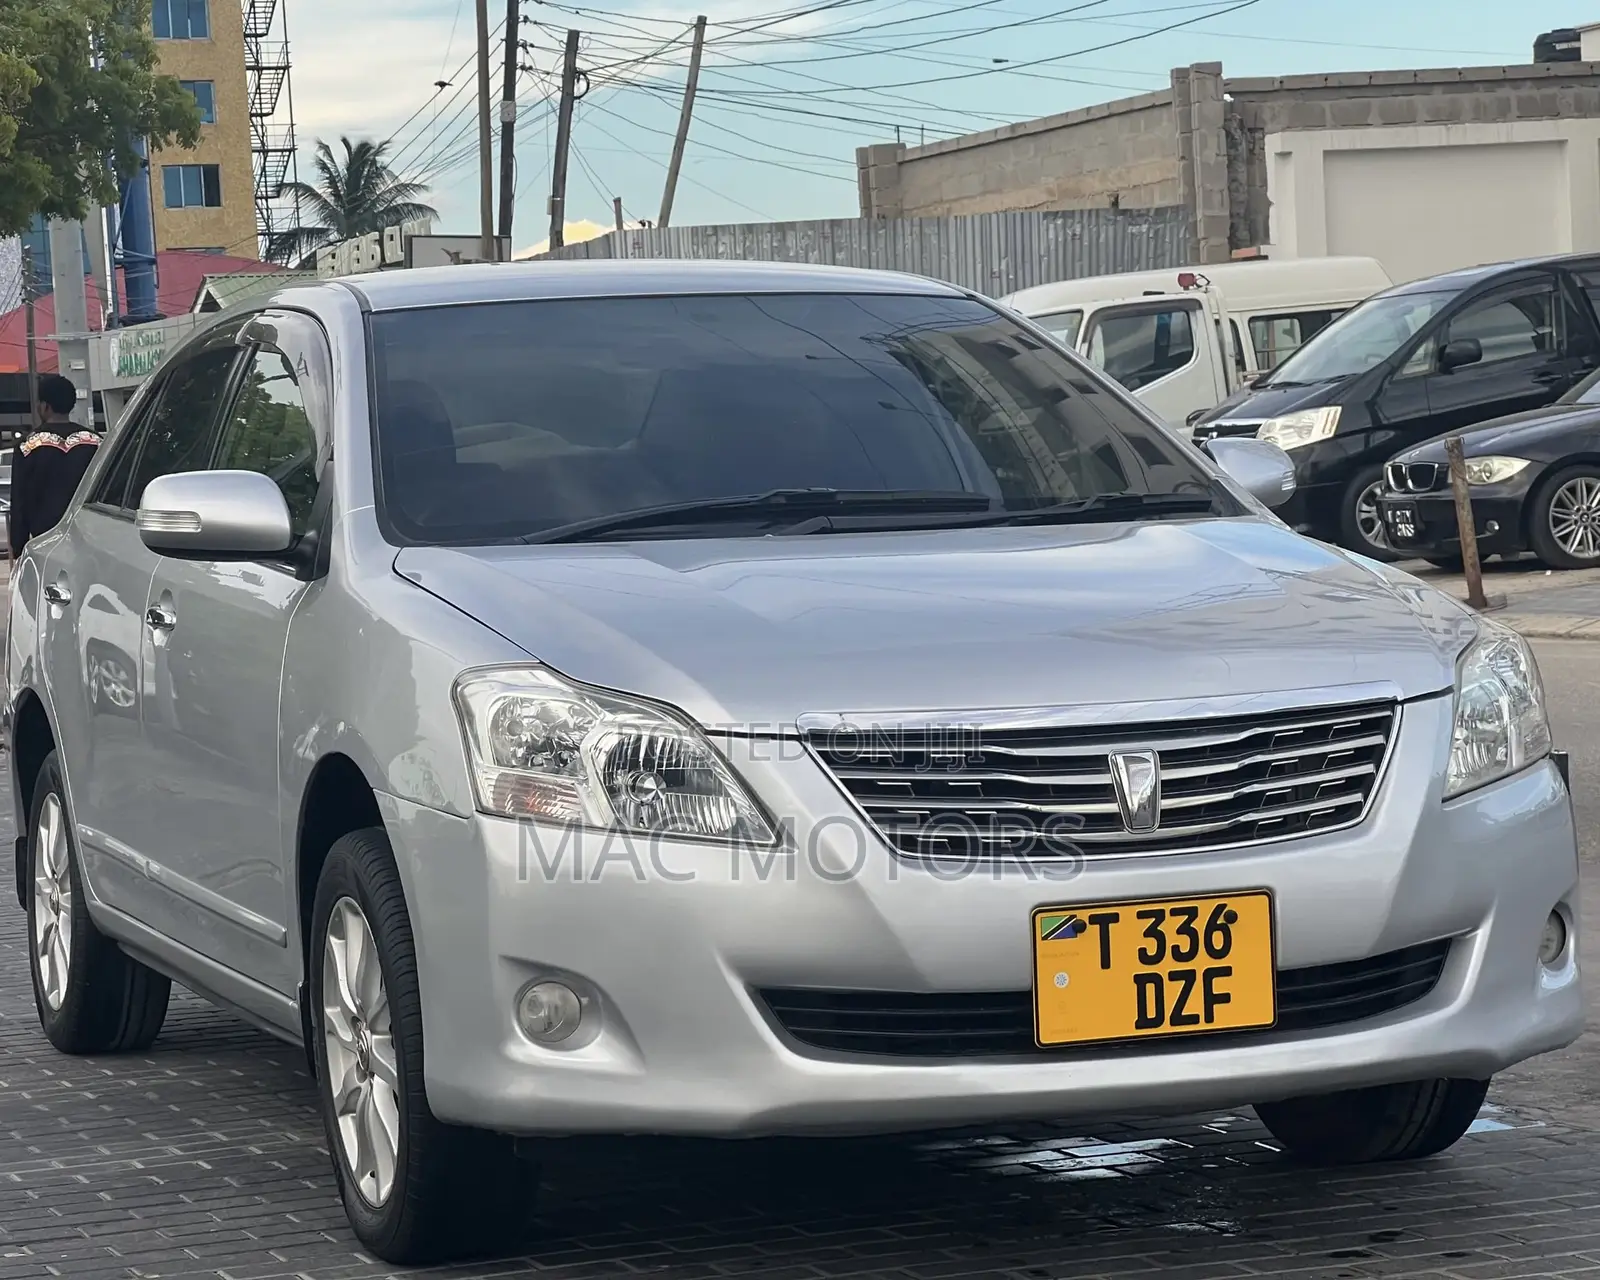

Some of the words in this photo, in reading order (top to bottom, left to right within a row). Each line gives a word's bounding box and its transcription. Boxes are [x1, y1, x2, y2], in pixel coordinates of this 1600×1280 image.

[1088, 912, 1120, 970] T
[1136, 903, 1233, 966] 336
[1133, 965, 1233, 1030] DZF
